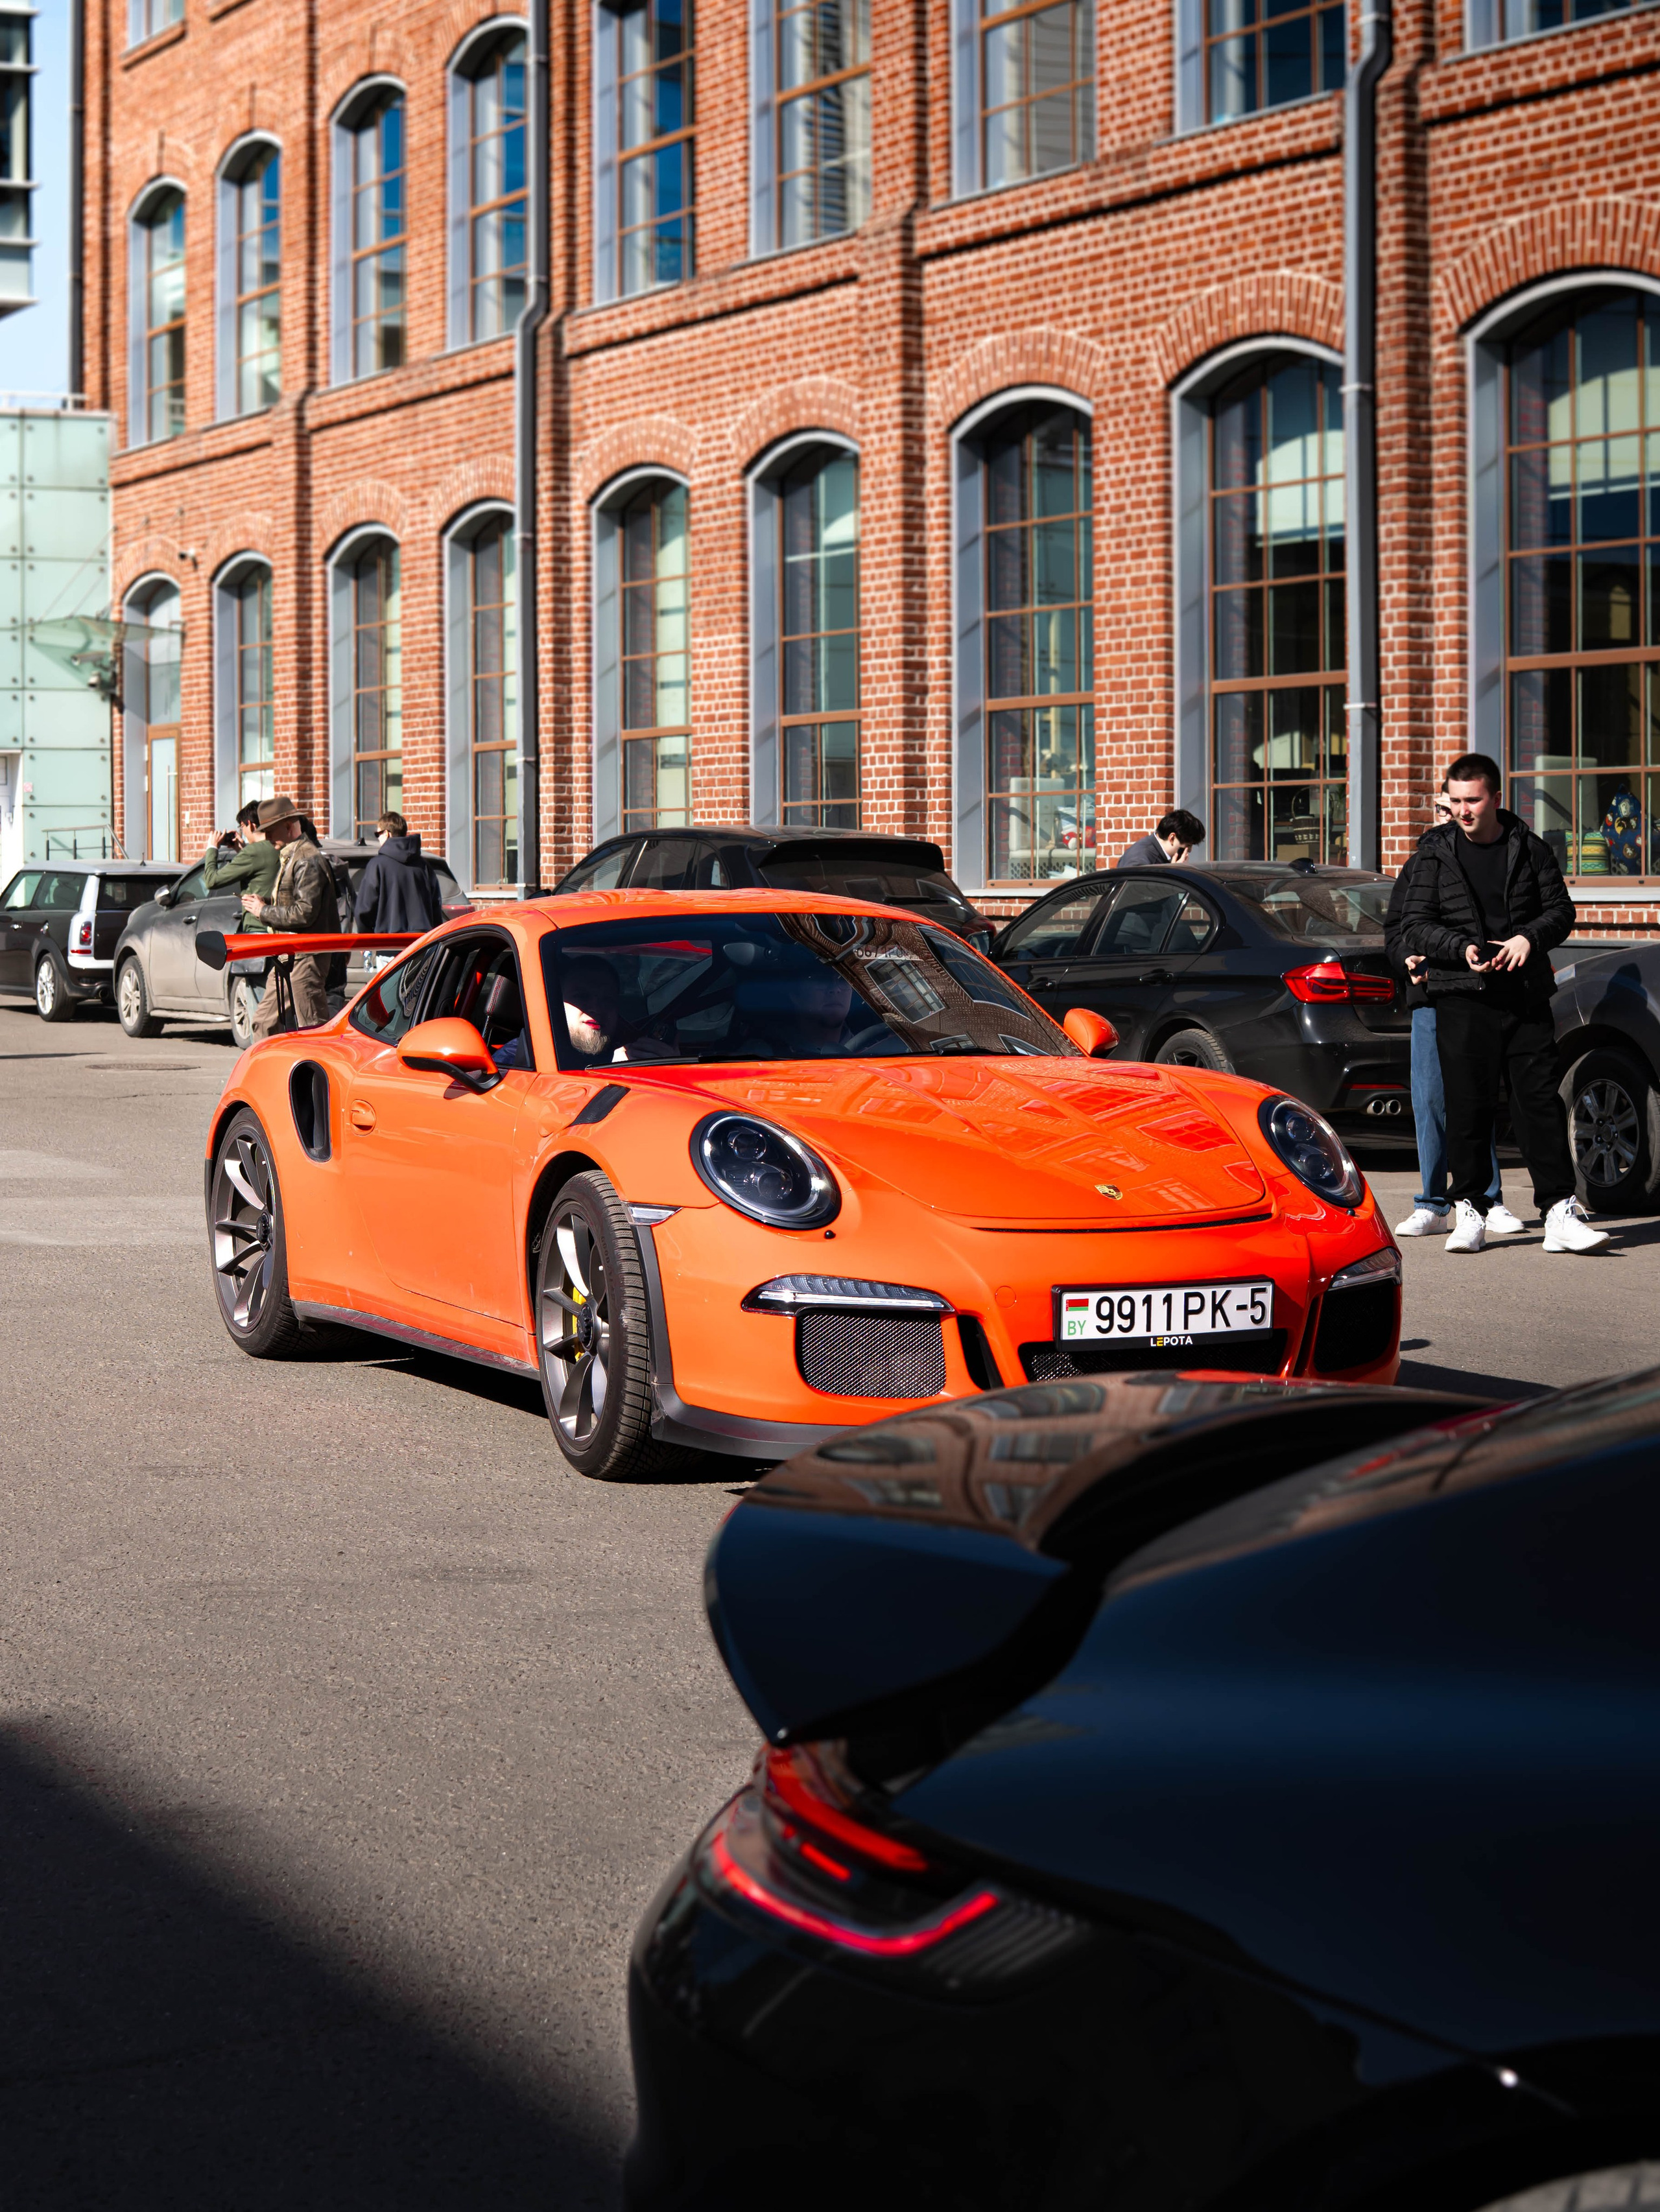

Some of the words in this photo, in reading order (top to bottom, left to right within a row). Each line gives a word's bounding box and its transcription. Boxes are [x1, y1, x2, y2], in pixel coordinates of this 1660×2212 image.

[1095, 1287, 1267, 1334] 9911PK-5
[1067, 1320, 1087, 1336] BY
[1150, 1335, 1193, 1347] LEPOTA
